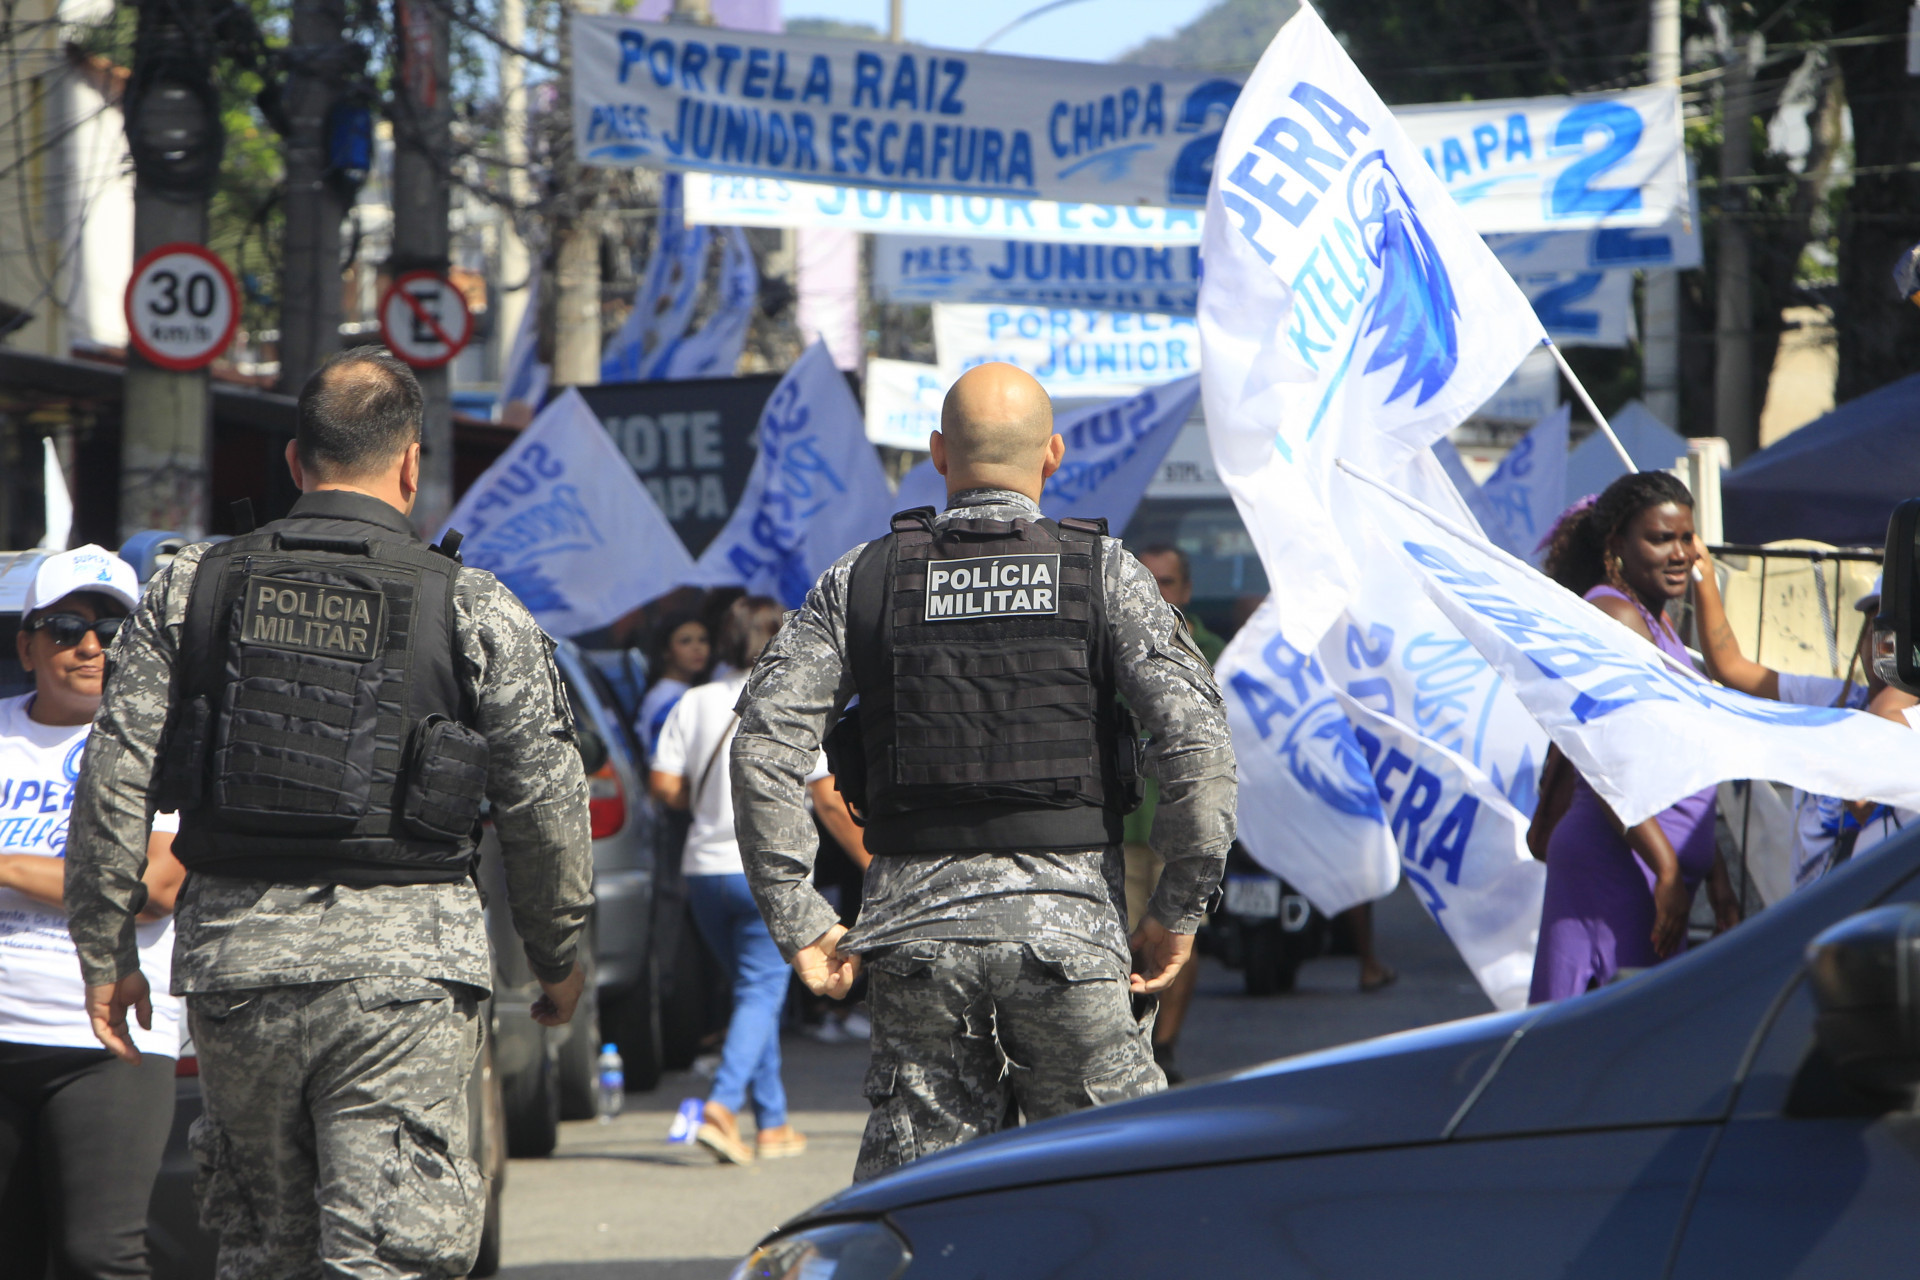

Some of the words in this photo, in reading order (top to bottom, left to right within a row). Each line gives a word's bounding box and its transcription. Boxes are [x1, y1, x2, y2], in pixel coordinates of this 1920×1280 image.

[617, 28, 832, 105] PORTELA
[852, 51, 968, 115] RAIZ
[661, 96, 818, 171] JUNIOR
[829, 112, 1035, 187] ESCAFURA
[1048, 82, 1166, 160] CHAPA
[1166, 78, 1240, 203] 2
[1543, 100, 1644, 220] 2
[987, 239, 1173, 282] JUNIOR
[148, 271, 217, 319] 30
[411, 288, 442, 343] E
[151, 322, 212, 343] km/h
[1034, 338, 1191, 378] JUNIOR
[931, 560, 1053, 592] POLÍCIA
[257, 586, 371, 625] POLÍCIA
[930, 588, 1053, 616] MILITAR
[253, 615, 368, 653] MILITAR
